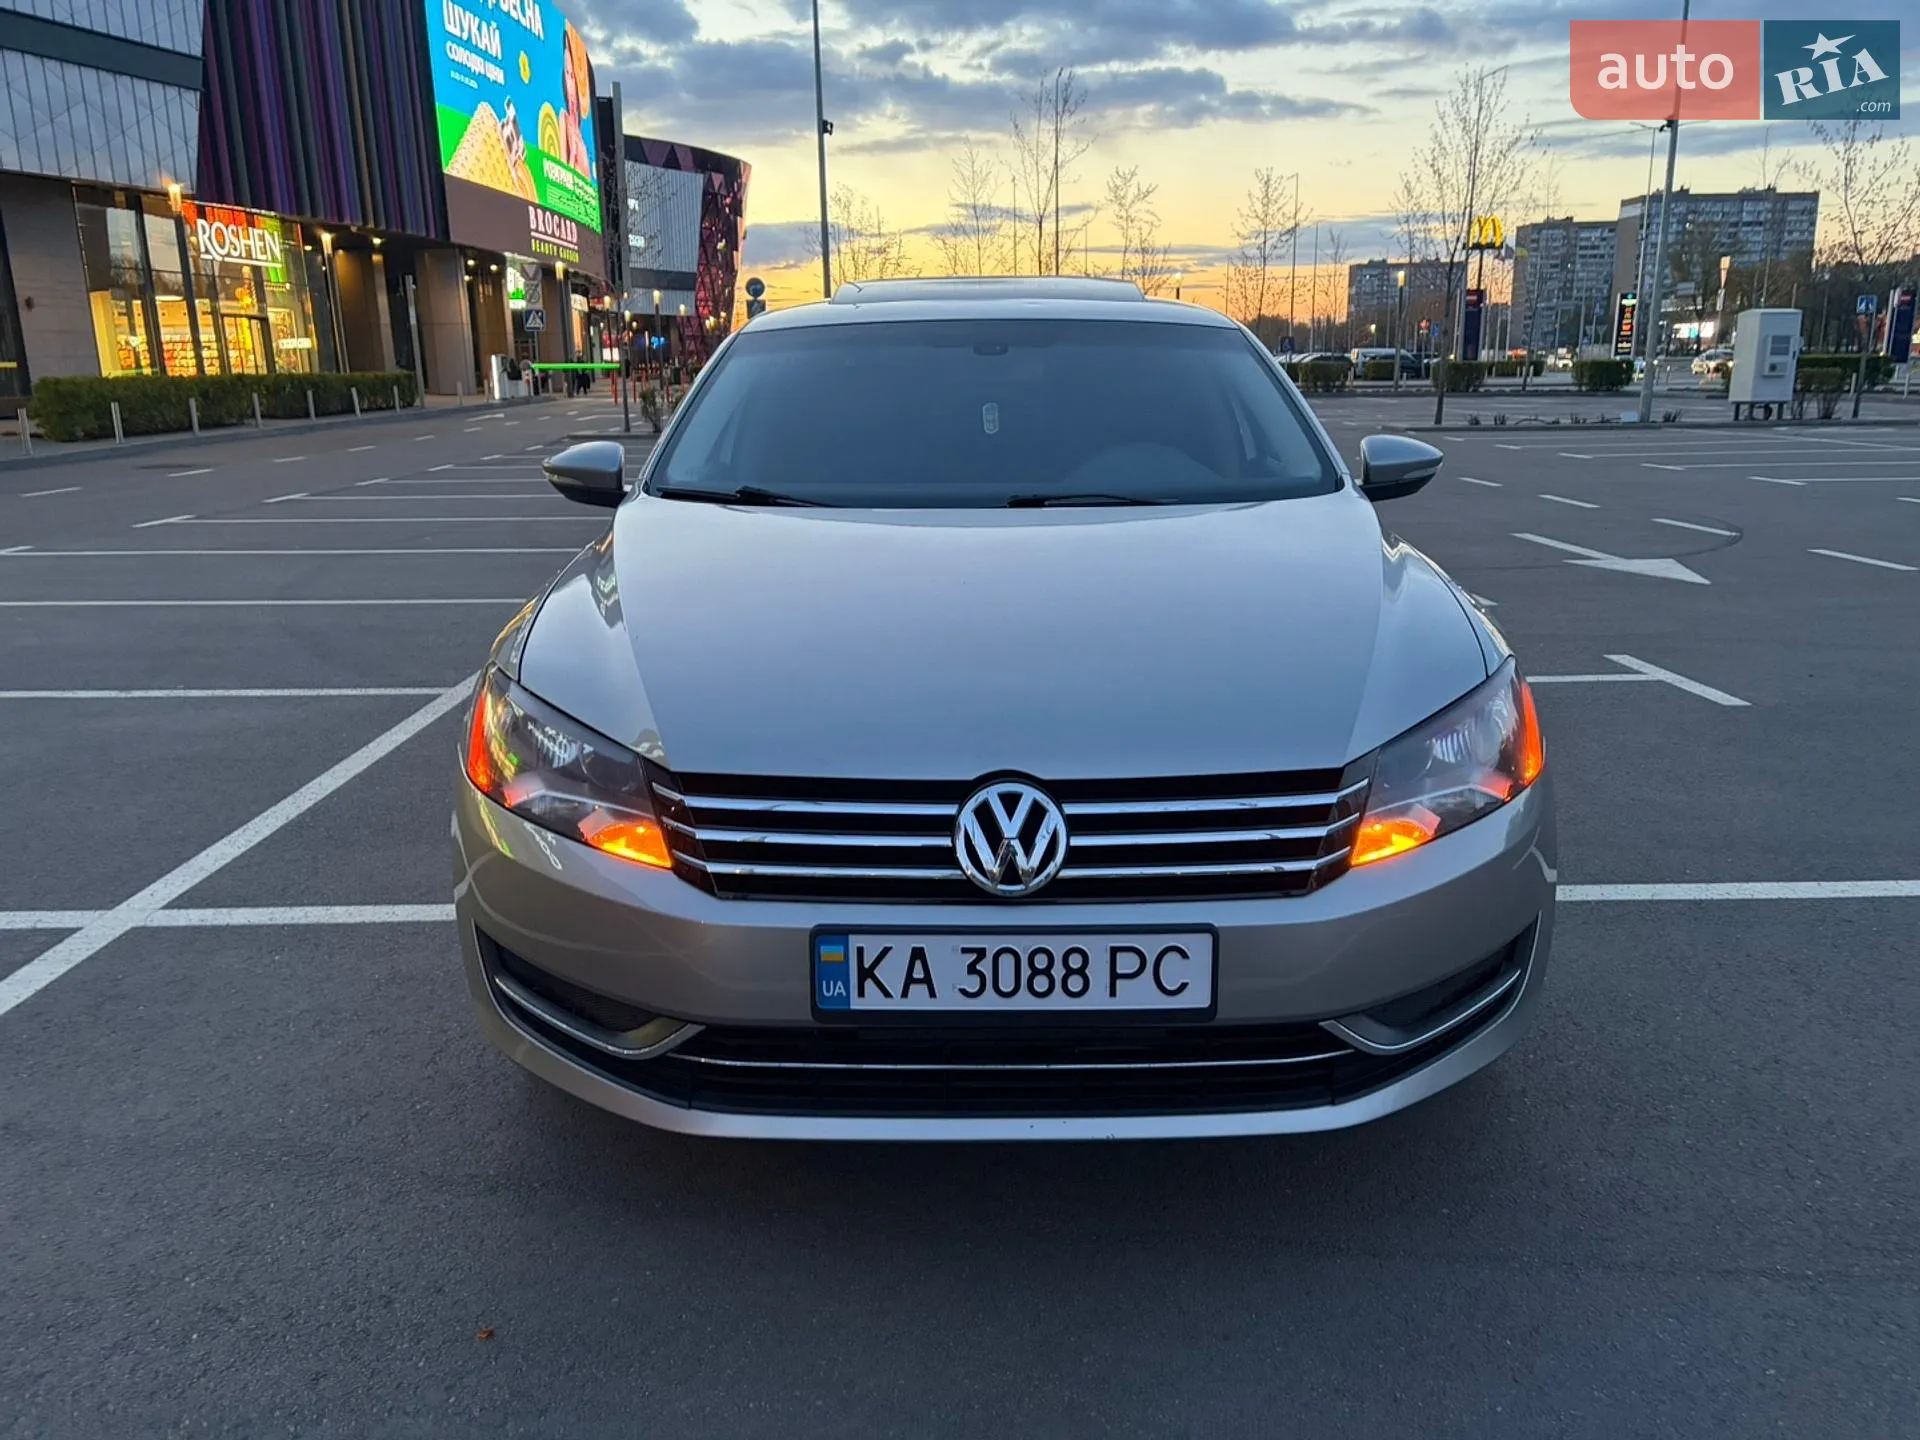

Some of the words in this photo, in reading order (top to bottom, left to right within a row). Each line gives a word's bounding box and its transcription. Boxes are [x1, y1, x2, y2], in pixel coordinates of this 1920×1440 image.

[442, 0, 502, 60] ШУКАЙ
[196, 218, 282, 262] ROSHEN
[528, 205, 578, 243] BROCARD
[822, 981, 846, 997] UA
[856, 945, 938, 998] KA
[957, 945, 1091, 998] 3088
[1108, 944, 1191, 998] PC
